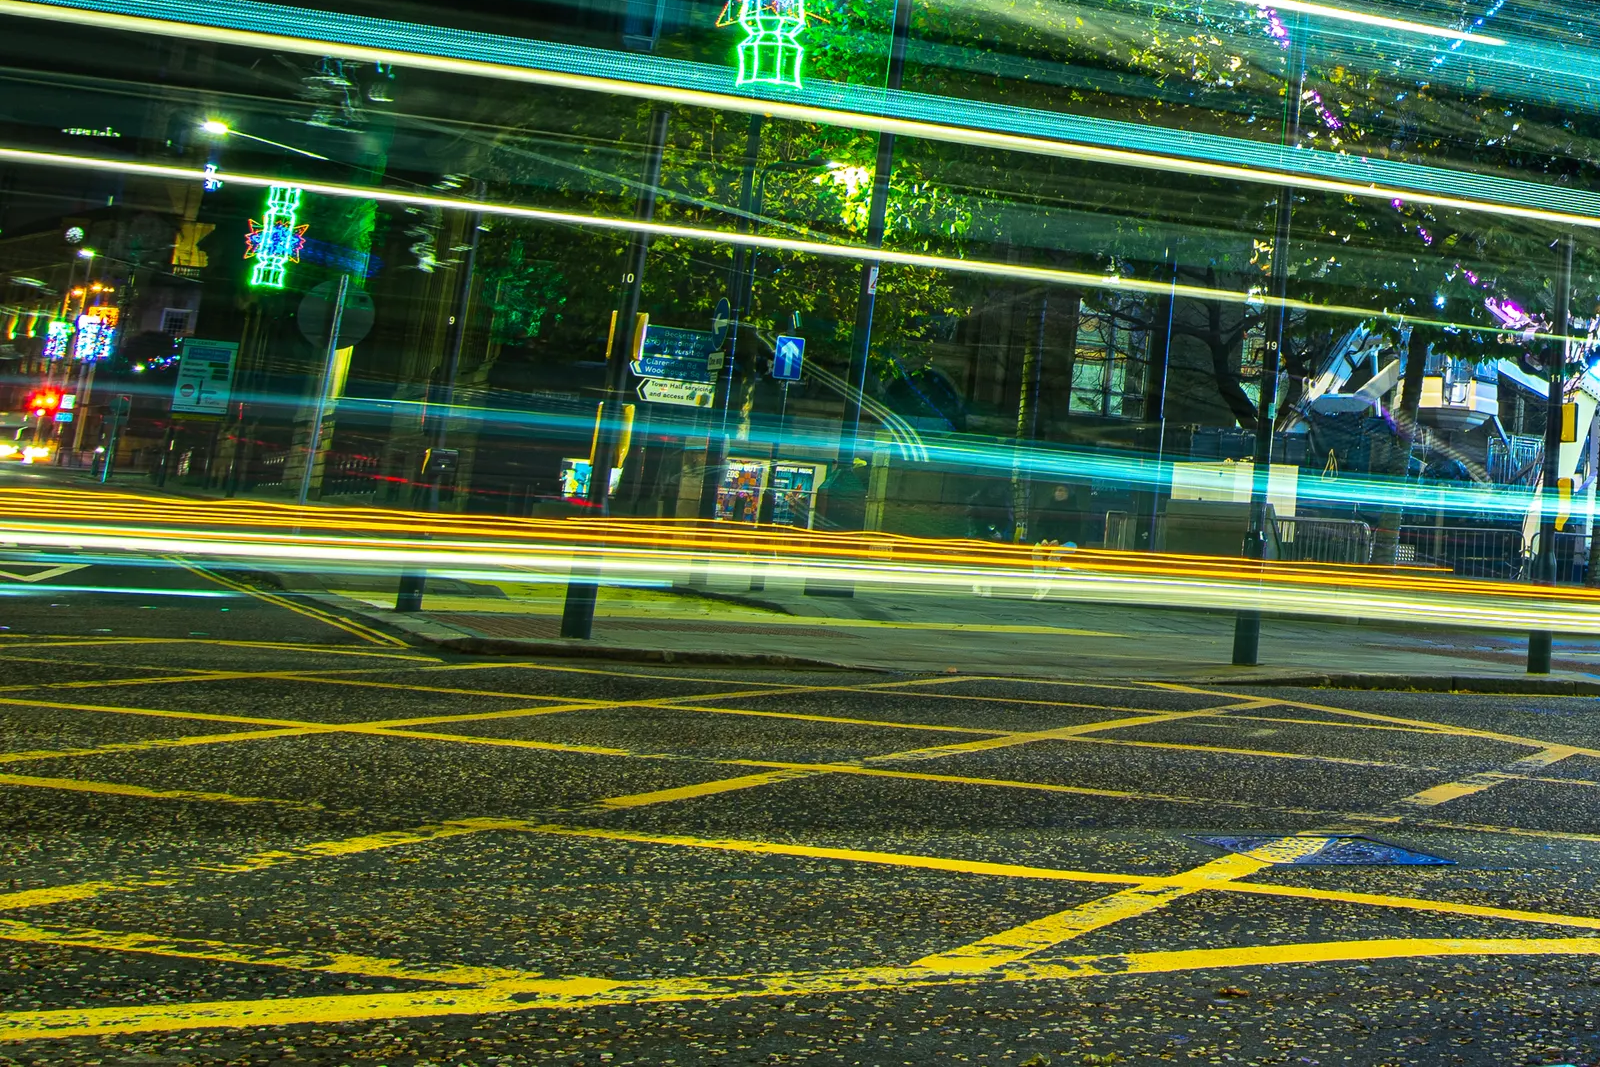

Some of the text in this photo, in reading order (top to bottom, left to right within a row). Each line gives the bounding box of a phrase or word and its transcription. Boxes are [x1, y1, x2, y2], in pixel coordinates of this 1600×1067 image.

[621, 273, 635, 283] 10
[449, 315, 455, 325] 9
[664, 330, 695, 340] Beckett
[663, 339, 704, 350] Headingley
[1266, 341, 1278, 351] 19
[646, 357, 684, 369] Clarendon
[644, 366, 687, 377] Woodhouse
[1551, 374, 1560, 383] 11
[651, 380, 713, 393] Town Hall servicing
[663, 393, 684, 401] access
